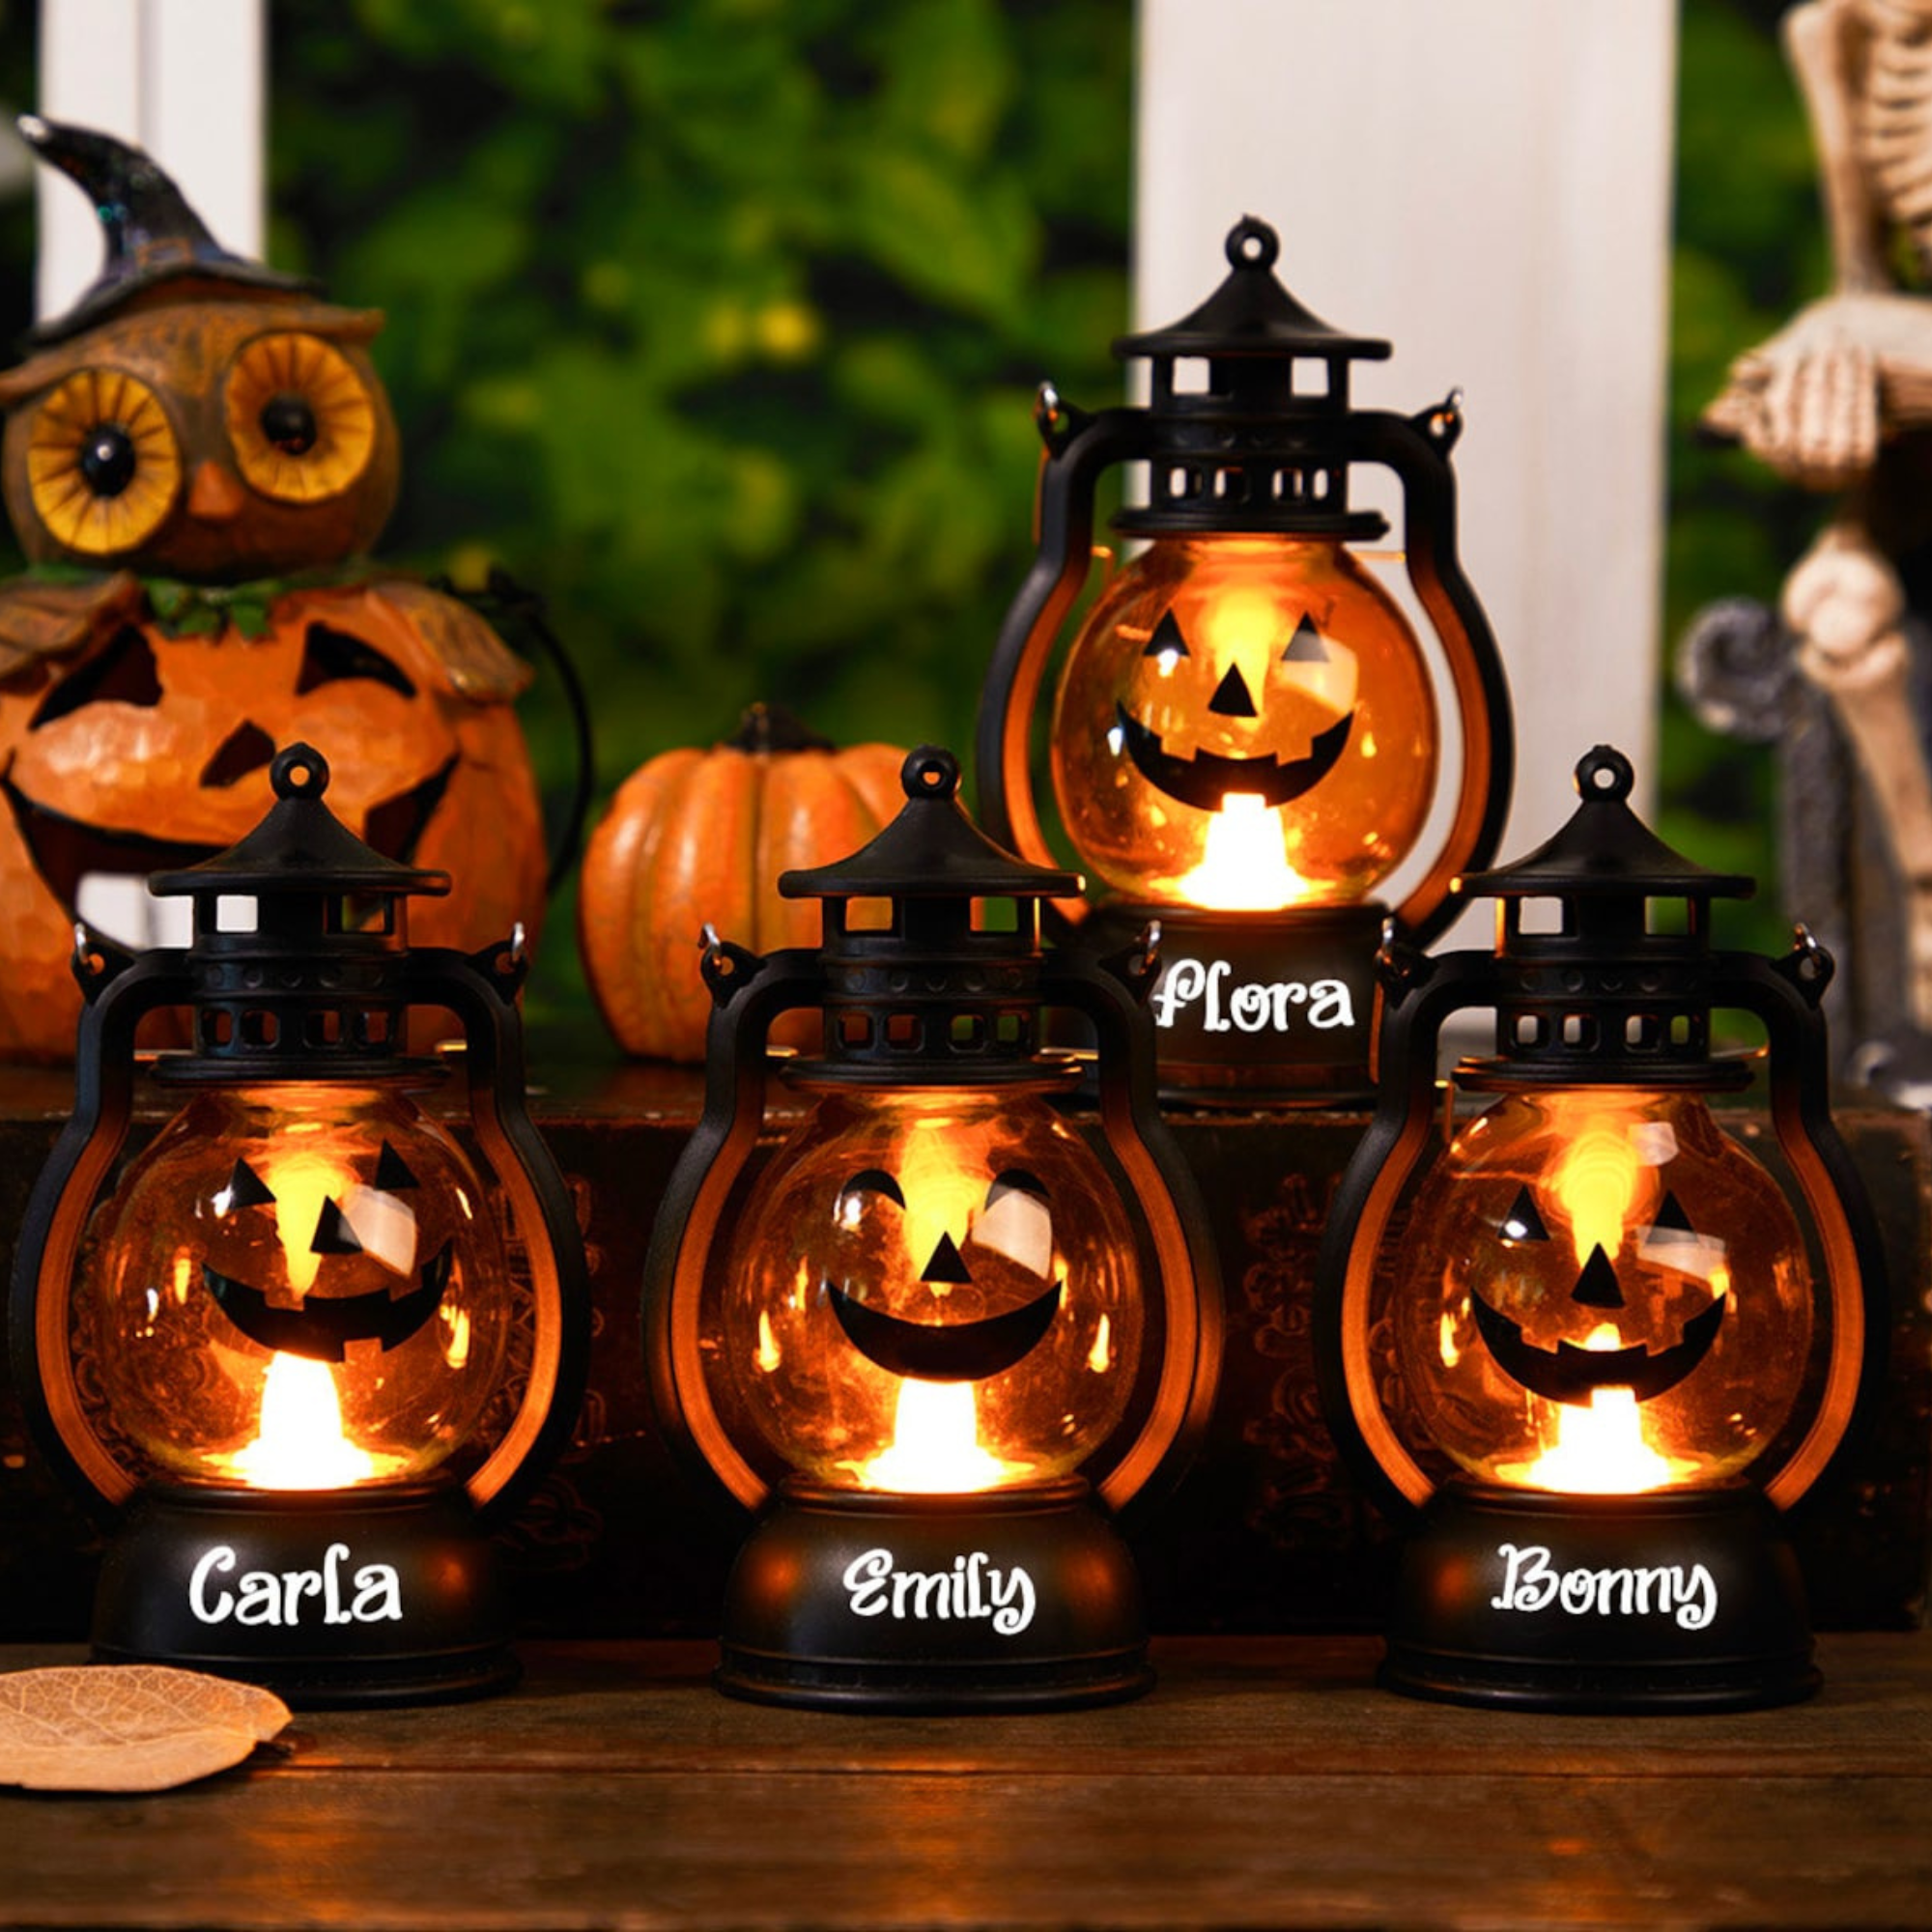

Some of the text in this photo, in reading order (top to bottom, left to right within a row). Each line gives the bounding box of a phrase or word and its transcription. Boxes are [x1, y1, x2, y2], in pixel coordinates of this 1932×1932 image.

[1152, 958, 1355, 1033] Flora
[188, 1543, 403, 1626] Carla
[842, 1548, 1037, 1635] Emily
[1491, 1543, 1718, 1631] Bonny
